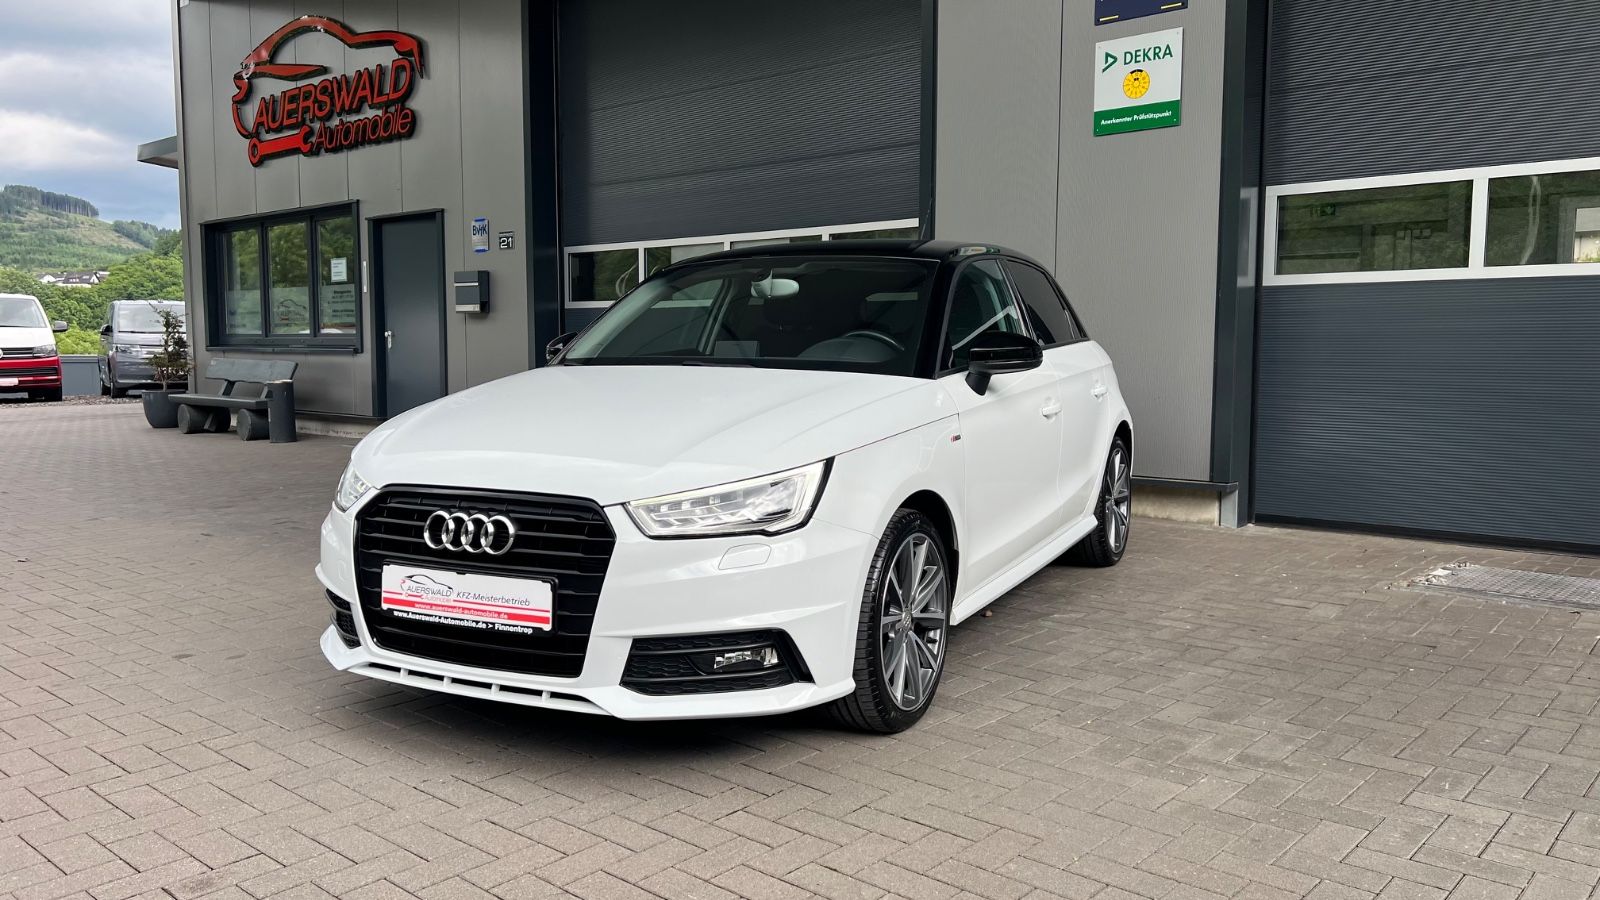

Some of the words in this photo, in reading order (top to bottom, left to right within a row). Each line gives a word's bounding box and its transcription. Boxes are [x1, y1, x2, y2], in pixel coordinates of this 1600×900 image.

[1123, 44, 1173, 65] DEKRA
[252, 58, 412, 134] AUERSWALD
[1101, 116, 1132, 125] Anerkannter
[1133, 110, 1172, 121] Prüfstützpunkt
[314, 106, 412, 151] Automobile
[500, 237, 513, 249] 21
[406, 585, 452, 597] AUERSWALD
[456, 591, 531, 607] KFZ-Meisterbetrieb
[414, 603, 508, 620] www.auerswald-automobile.de
[393, 610, 487, 629] www.Auerswald-Automobile.de
[494, 623, 533, 635] Finnentrop
